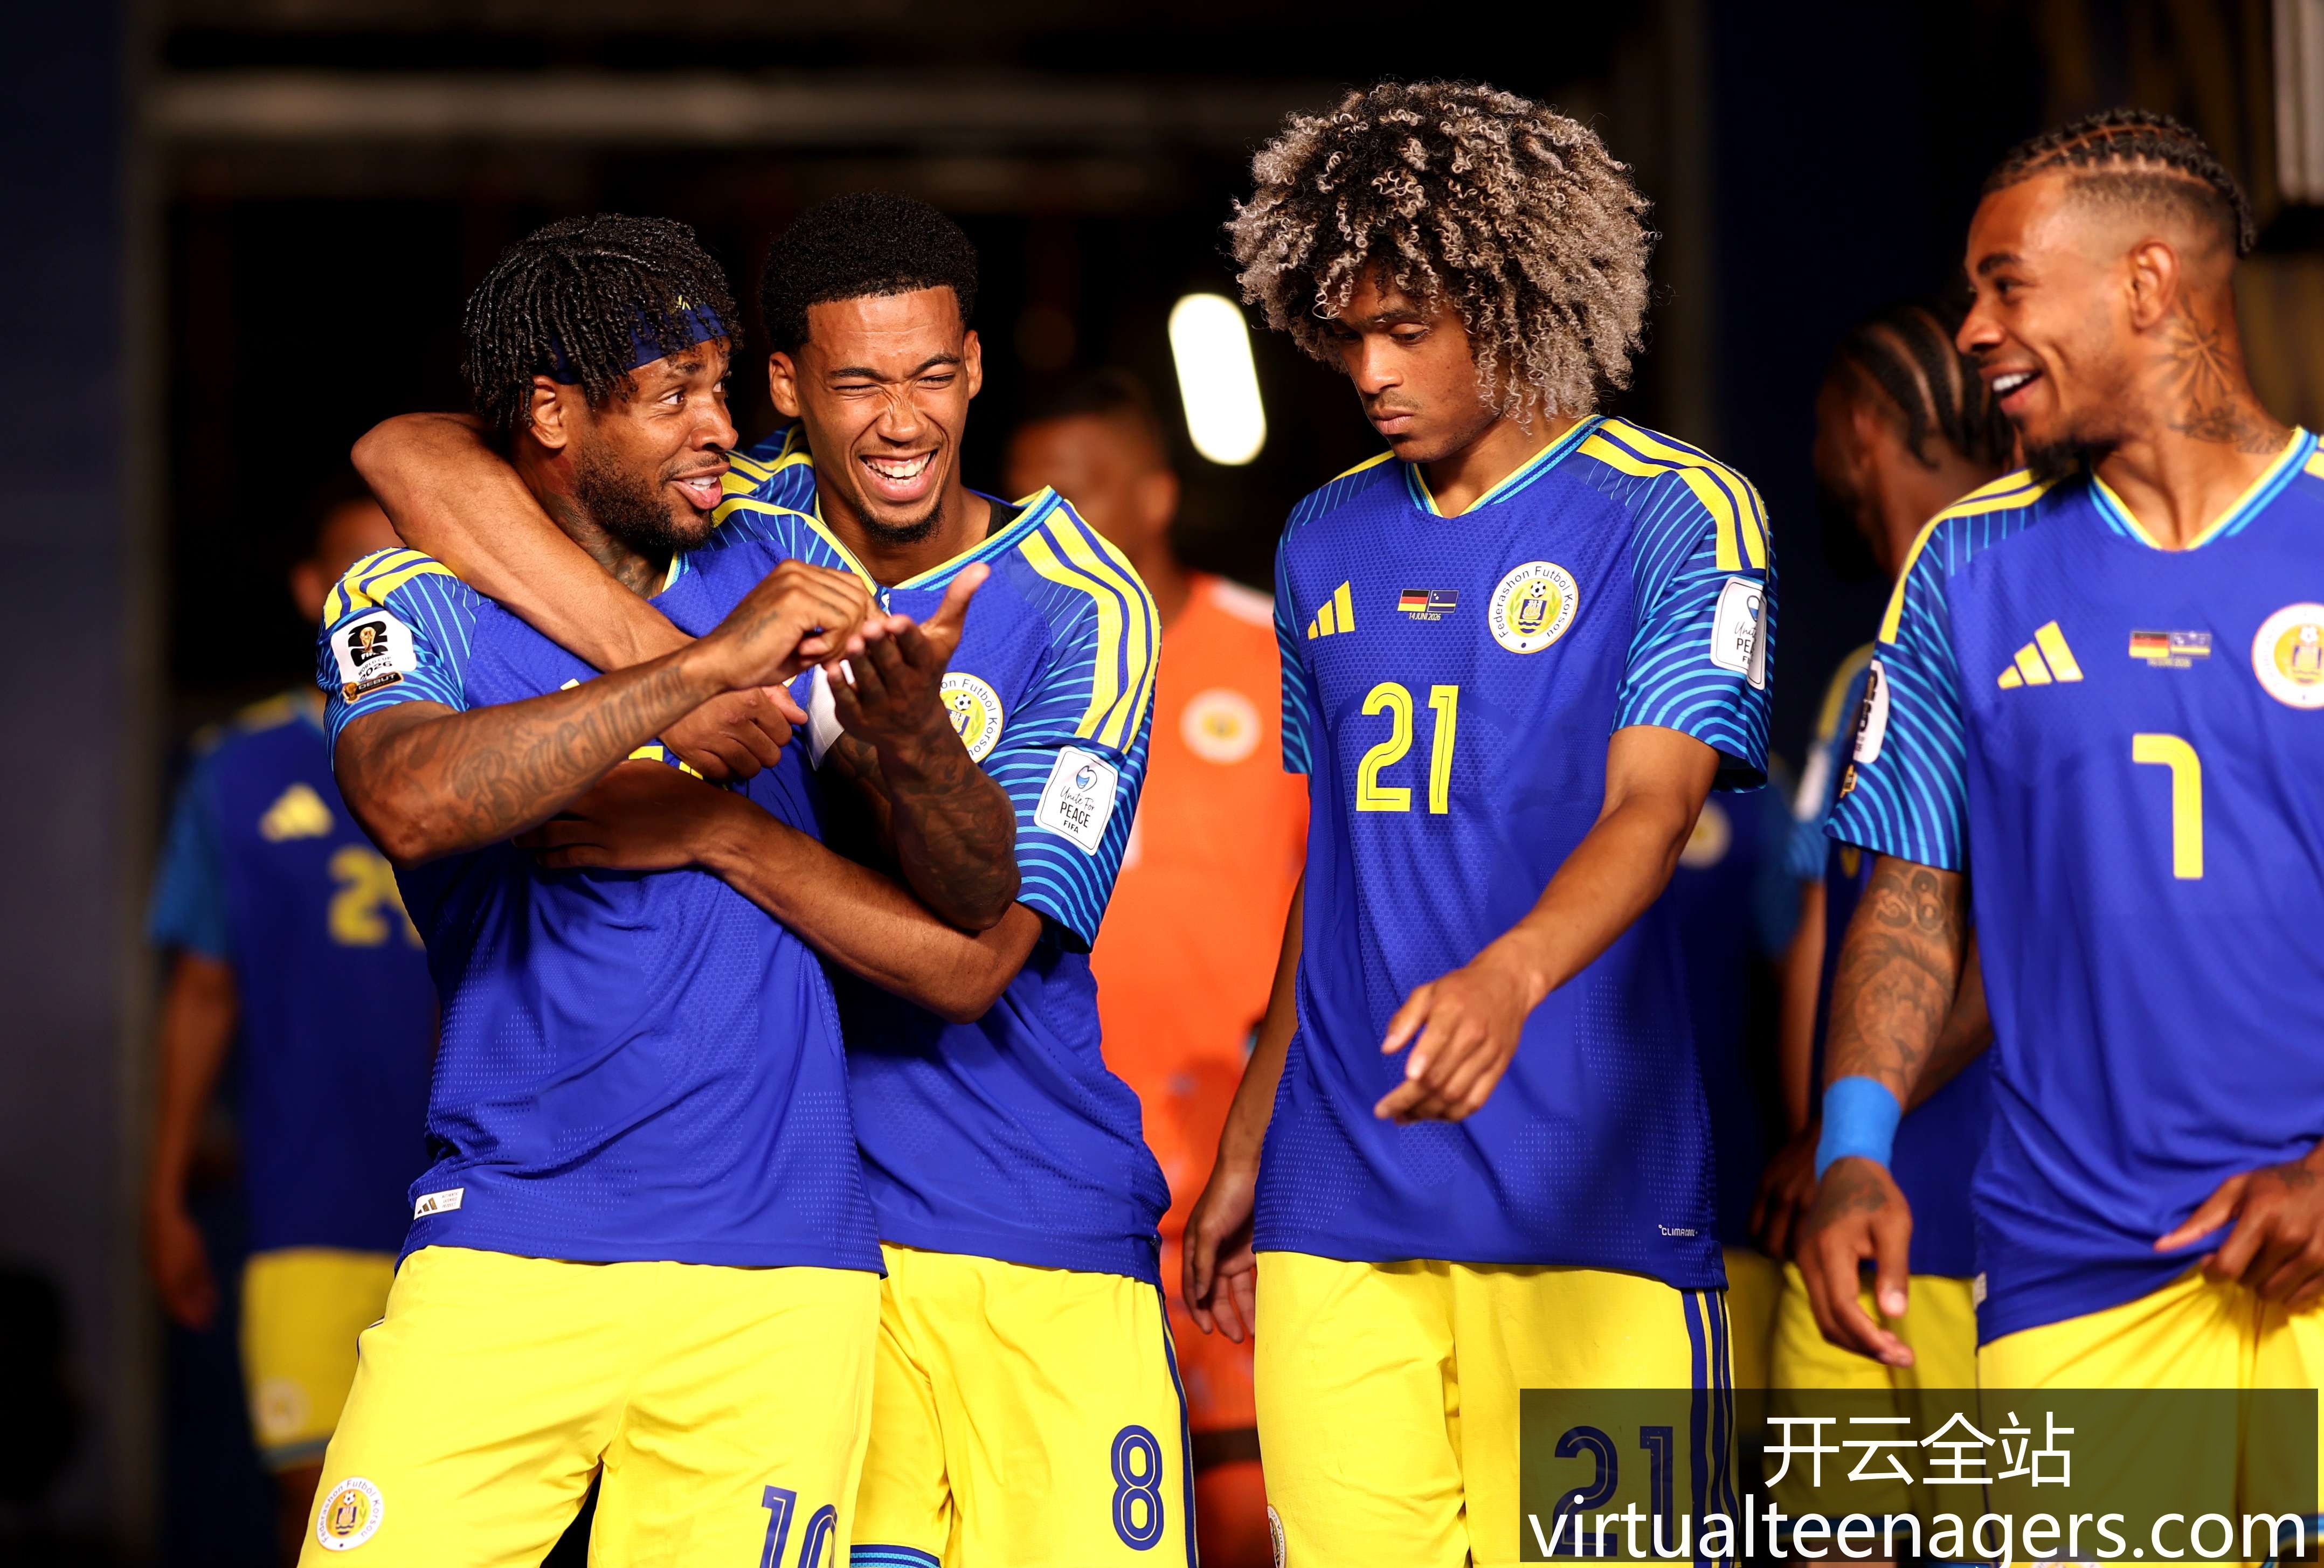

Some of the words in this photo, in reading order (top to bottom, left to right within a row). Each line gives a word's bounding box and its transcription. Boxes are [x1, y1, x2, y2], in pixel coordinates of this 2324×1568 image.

[1493, 571, 1530, 638] Federashon
[358, 660, 376, 676] WORLD
[358, 674, 396, 690] DEBUT
[1356, 682, 1459, 815] 21
[1060, 786, 1083, 804] Unite
[1084, 797, 1095, 810] For
[1060, 801, 1091, 828] PEACE
[2132, 732, 2203, 880] 7
[1063, 820, 1078, 834] FIFA
[1110, 1424, 1165, 1551] 8
[1552, 1425, 1673, 1557] 21
